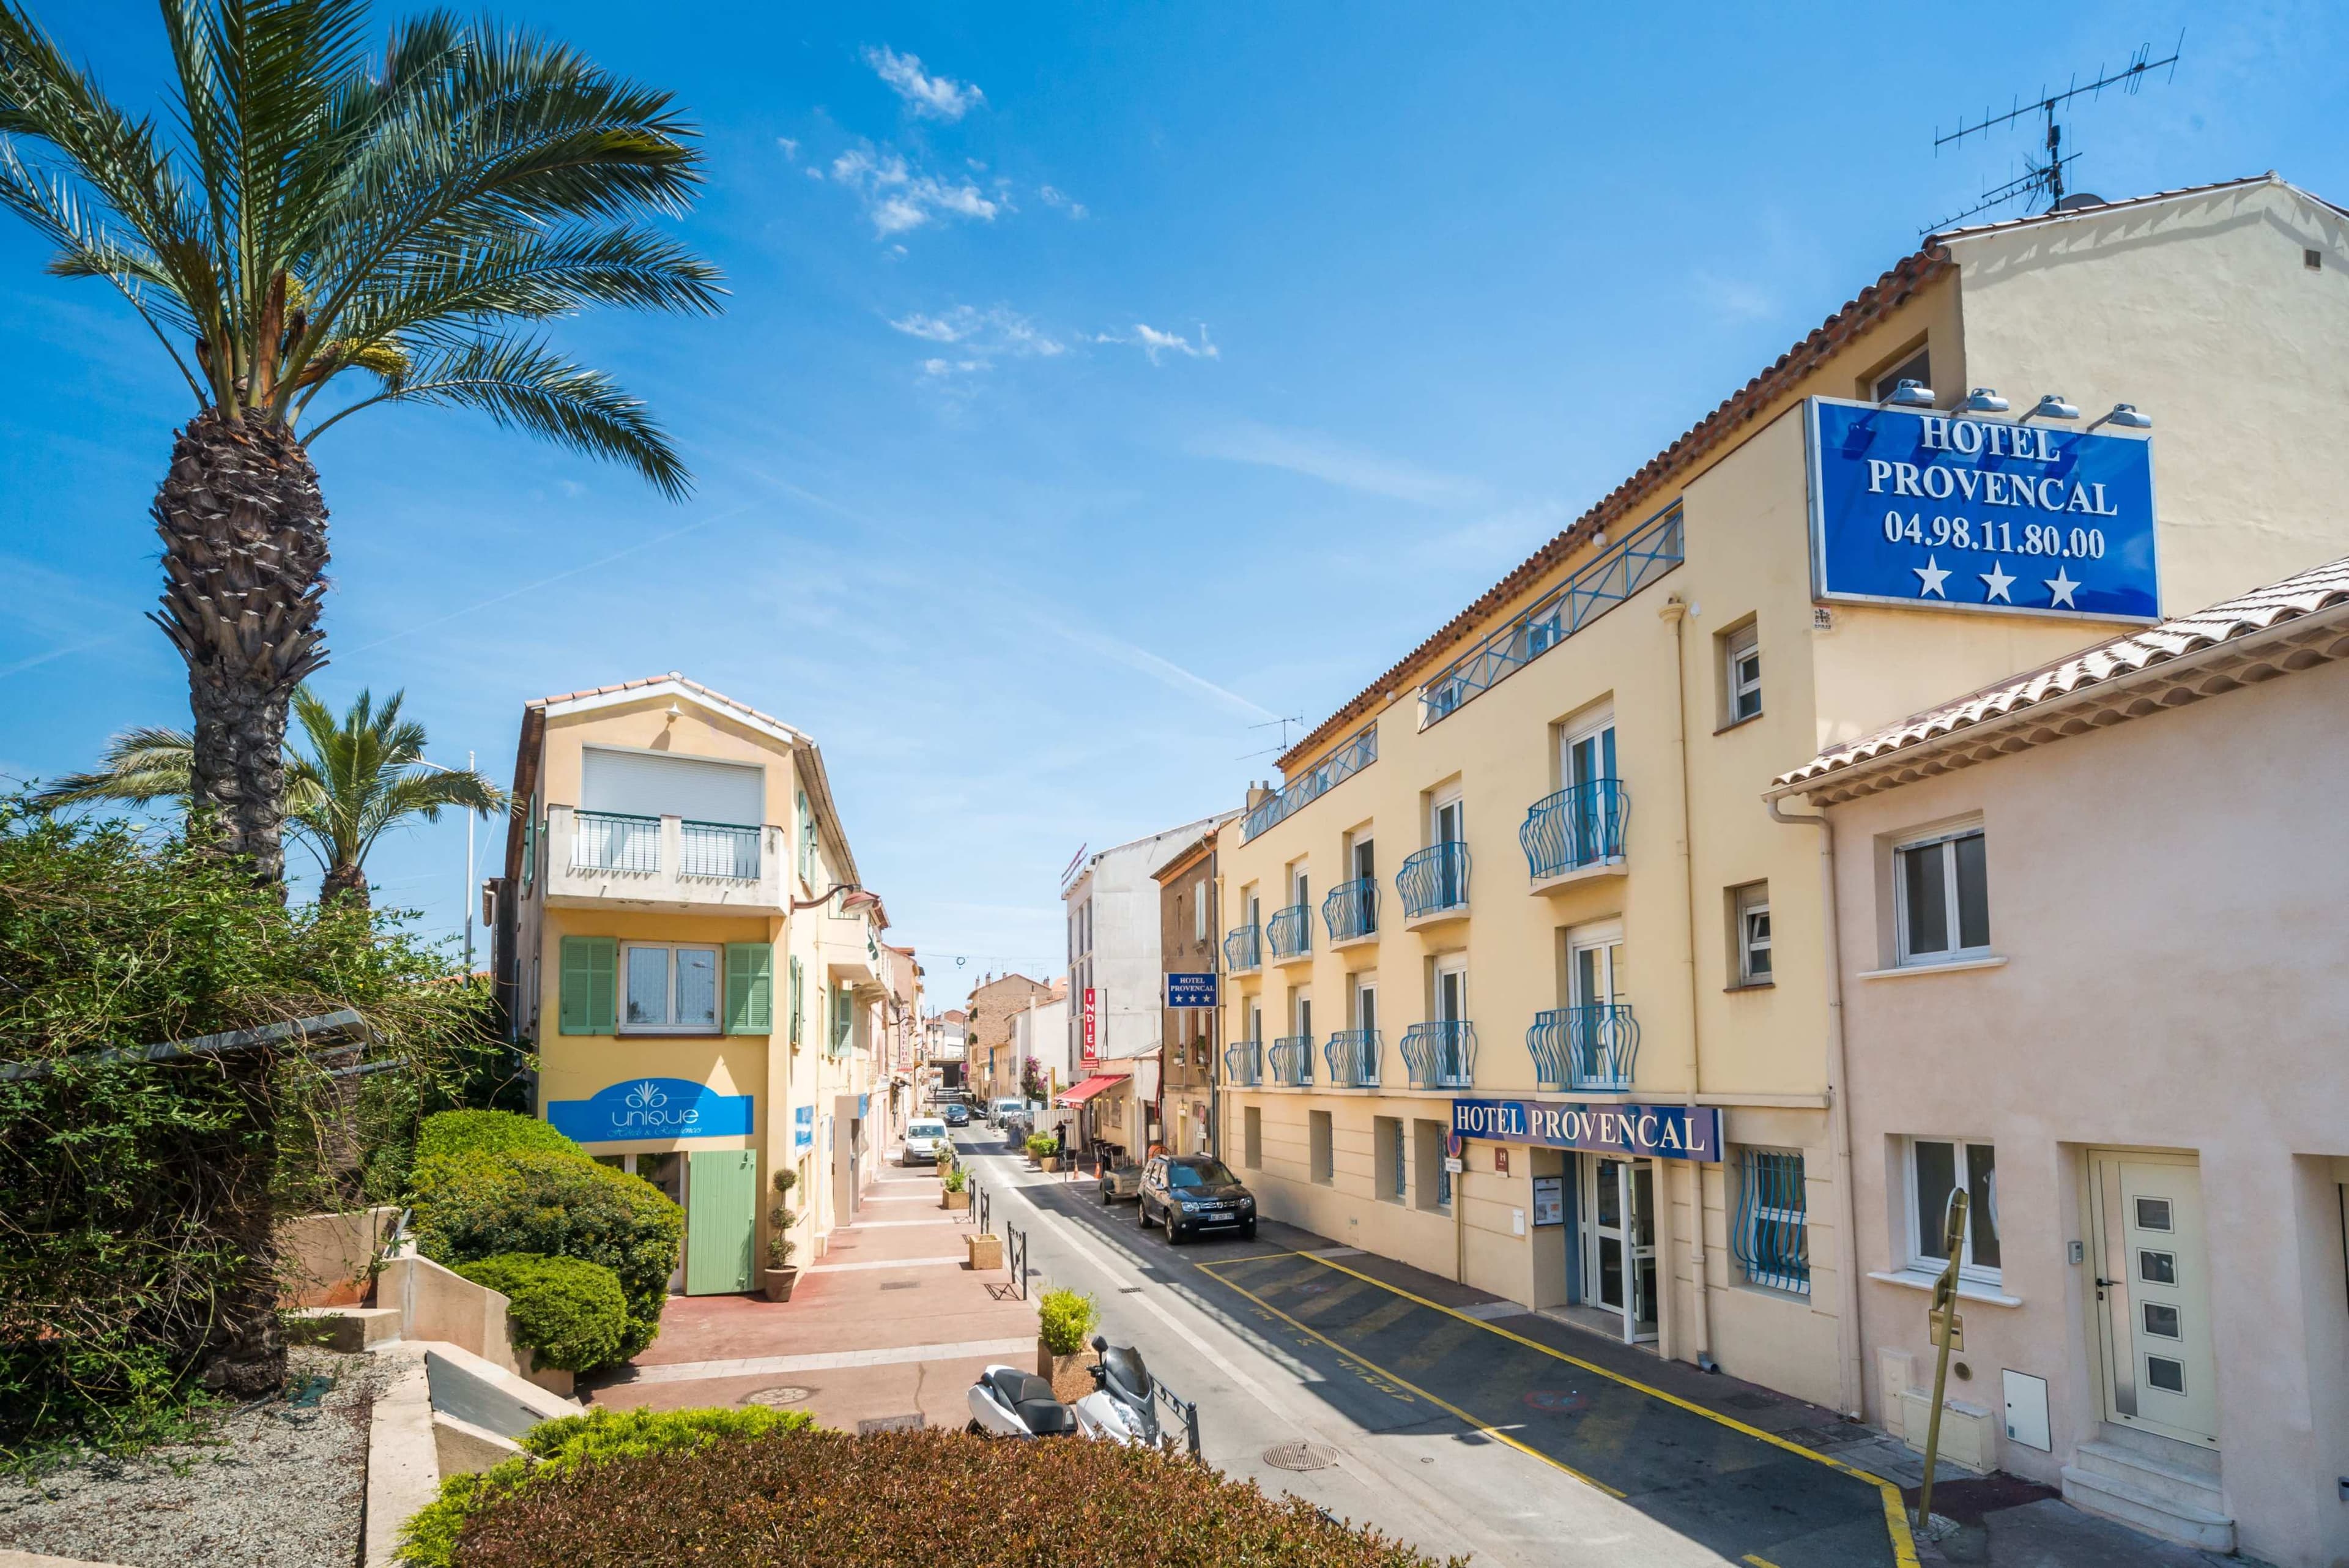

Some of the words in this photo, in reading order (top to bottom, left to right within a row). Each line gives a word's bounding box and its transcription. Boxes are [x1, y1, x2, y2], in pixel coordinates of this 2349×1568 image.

[1920, 416, 2060, 462] HOTEL
[1868, 459, 2118, 516] PROVENCAL
[1885, 511, 2105, 559] 04.98.11.80.00
[1085, 994, 1095, 1053] INDIEN
[1456, 1105, 1523, 1135] HOTEL
[1531, 1110, 1705, 1151] PROVENCAL
[1500, 1152, 1506, 1162] H
